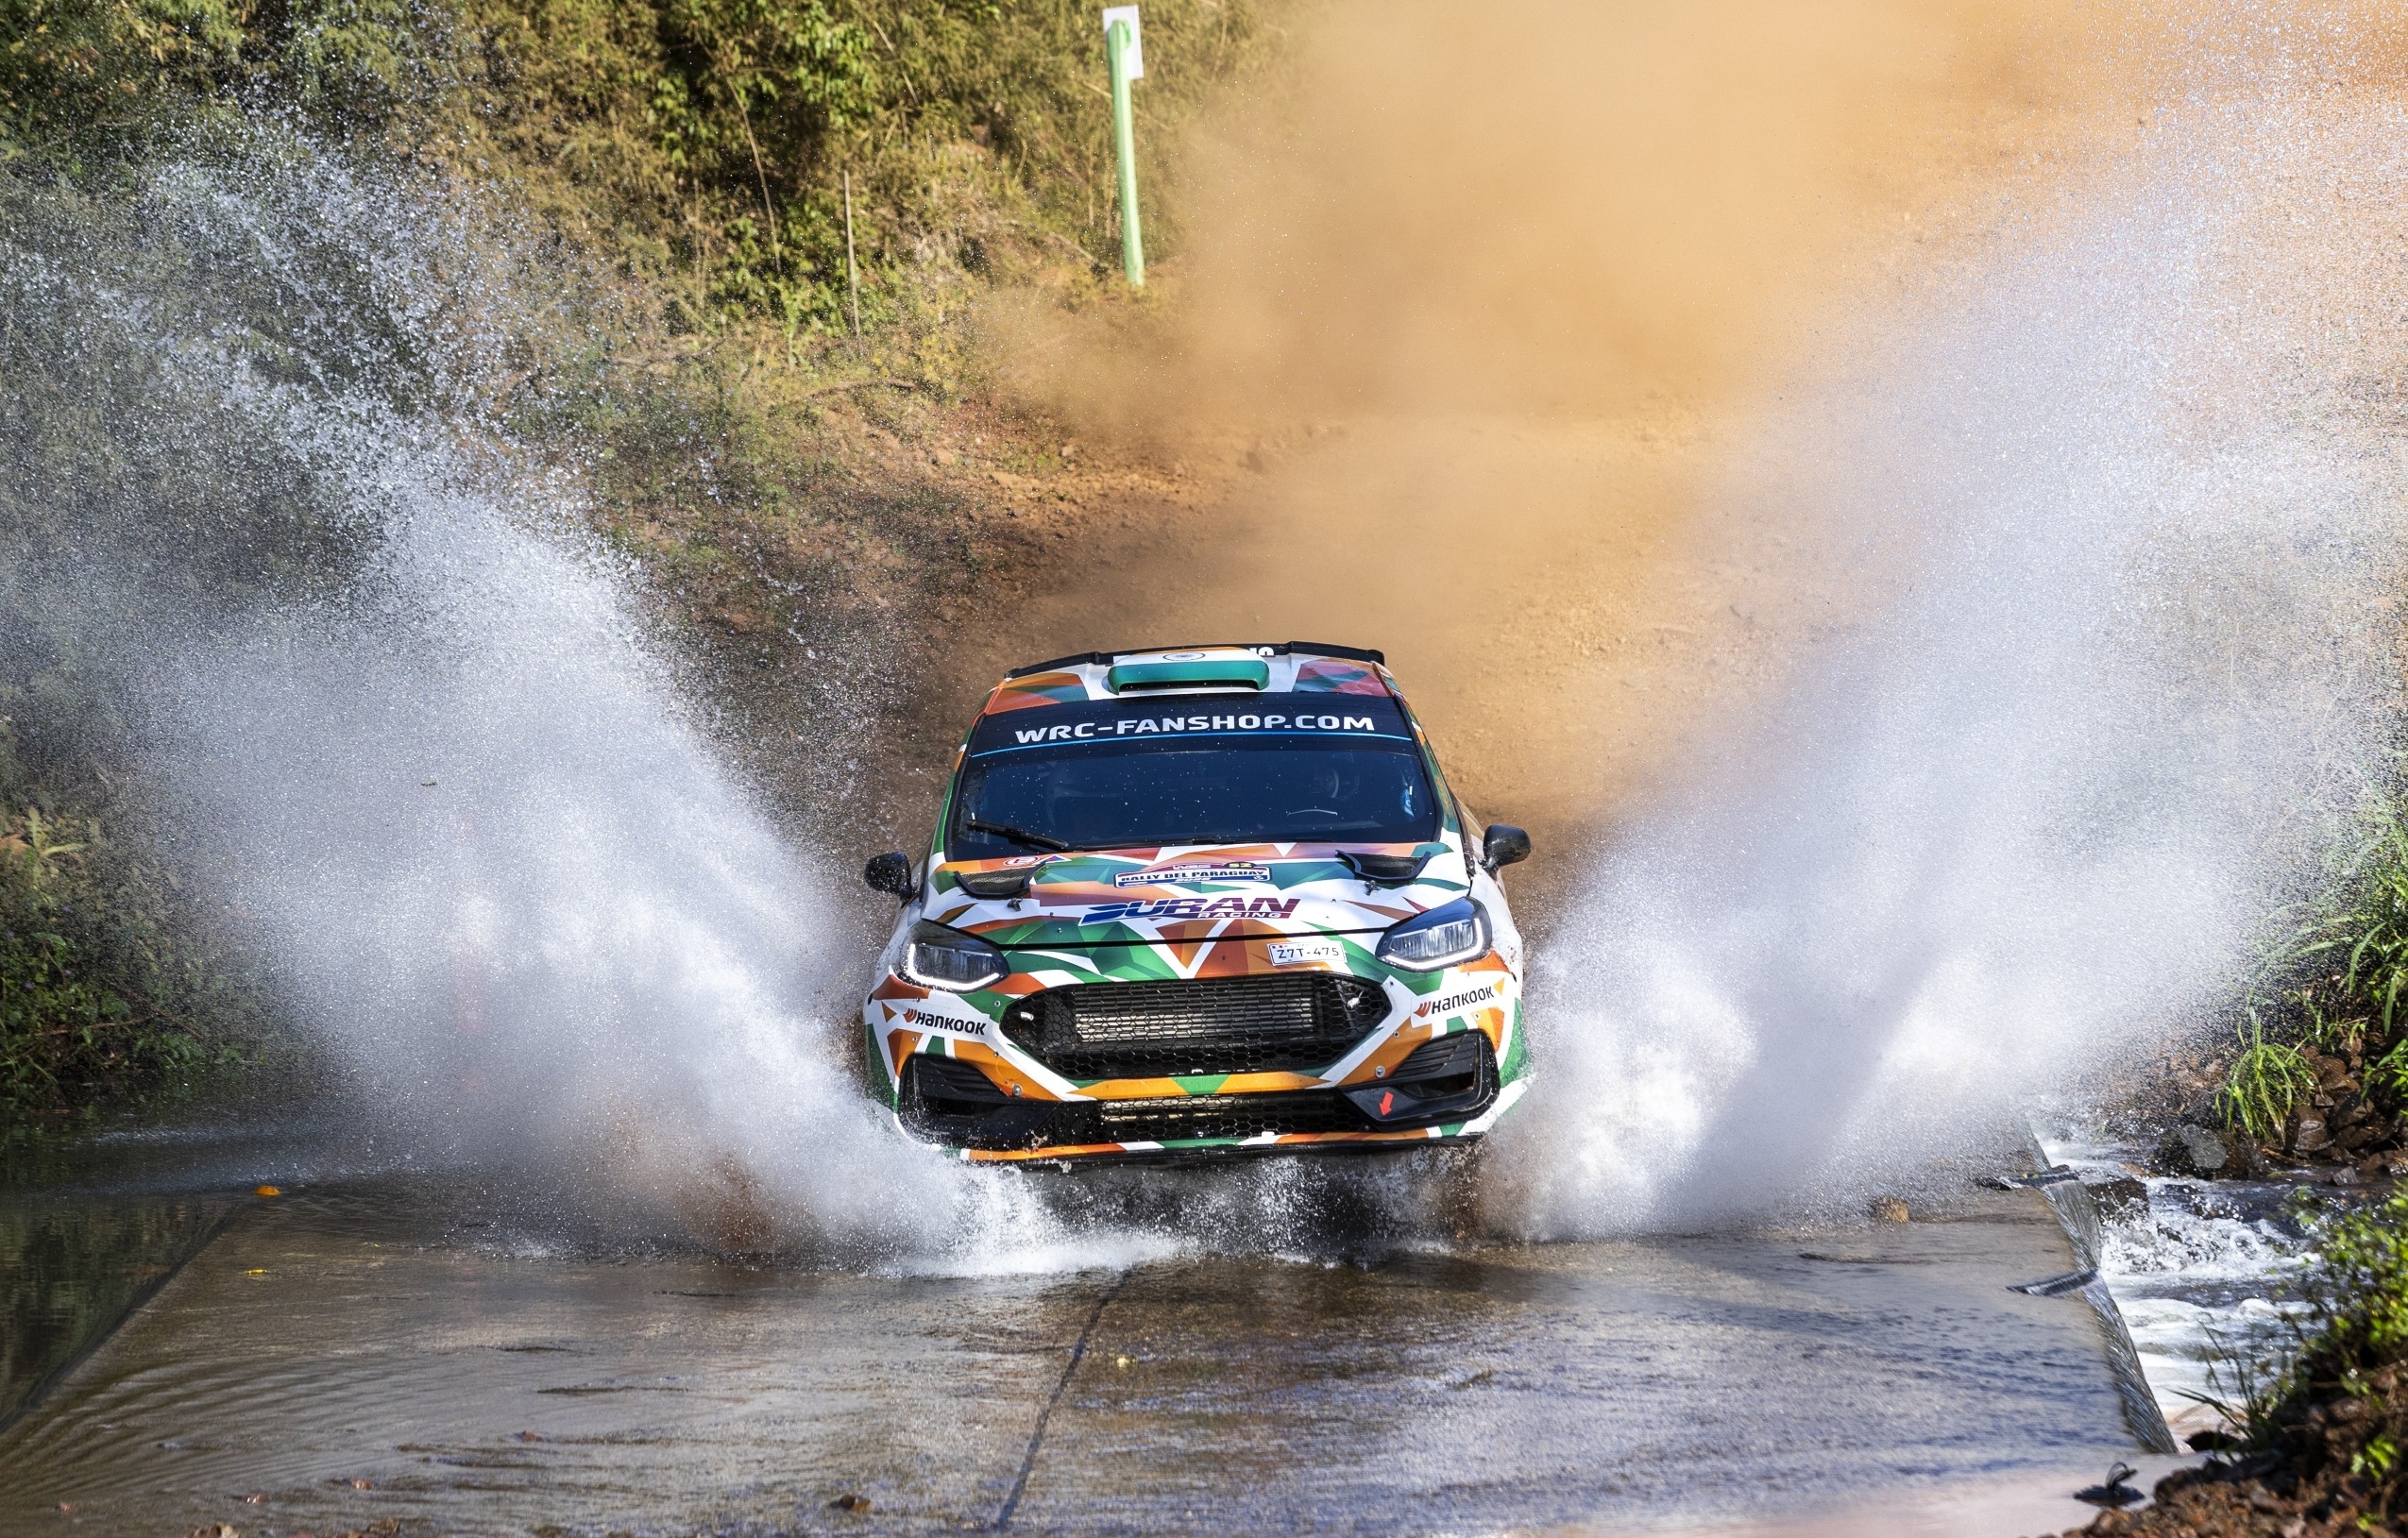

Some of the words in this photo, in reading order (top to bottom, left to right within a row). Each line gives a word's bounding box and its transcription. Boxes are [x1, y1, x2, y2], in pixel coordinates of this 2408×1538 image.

[1015, 715, 1375, 743] WRC-FANSHOP.COM
[1121, 873, 1161, 882] RALLY
[1080, 897, 1301, 924] DURAN
[1276, 947, 1339, 959] Z7T-475
